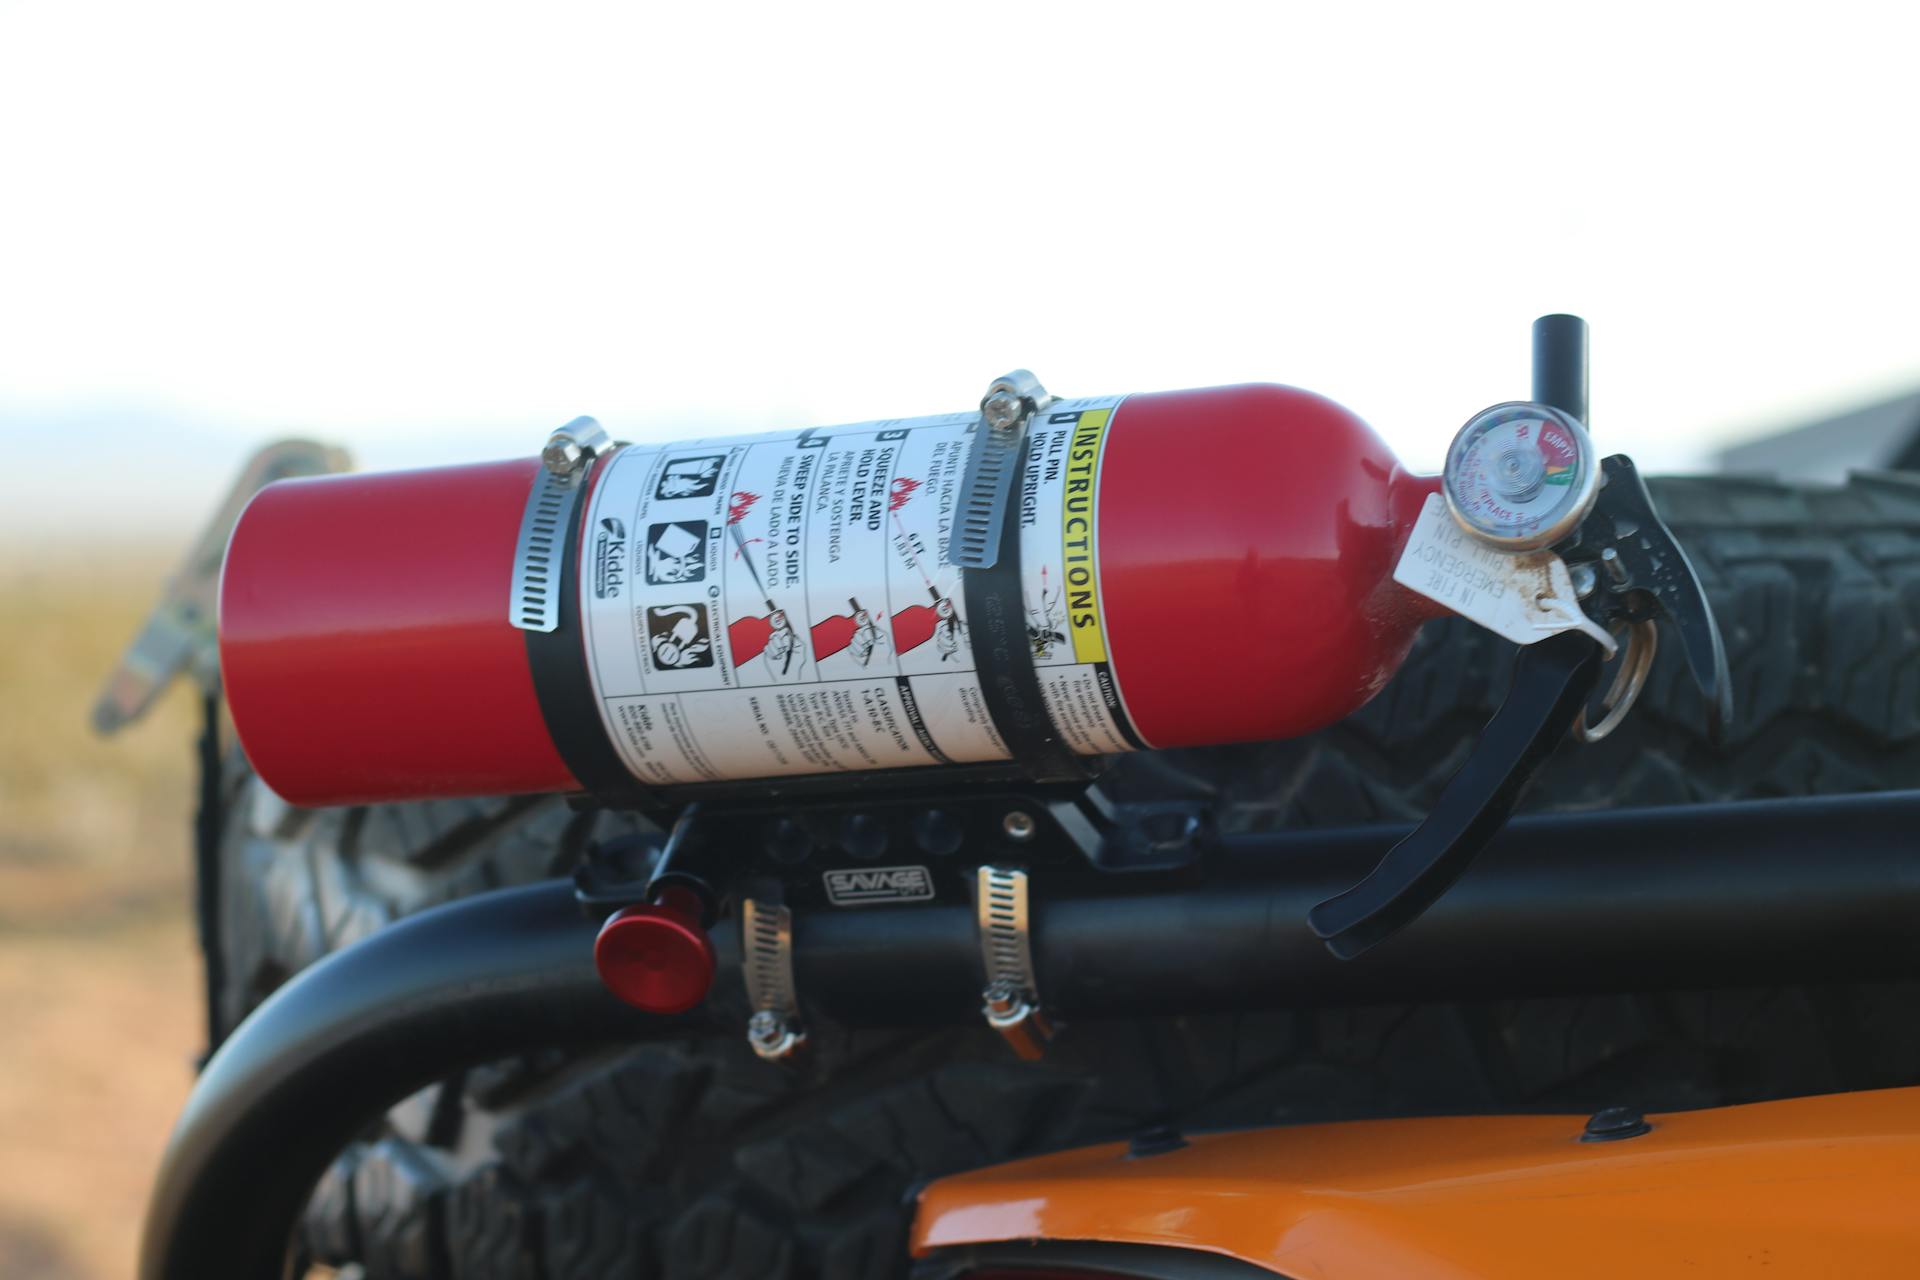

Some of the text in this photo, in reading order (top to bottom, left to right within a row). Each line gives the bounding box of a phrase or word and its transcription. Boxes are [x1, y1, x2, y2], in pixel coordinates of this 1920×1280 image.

[925, 441, 948, 497] DEL FUEGO.
[1043, 430, 1067, 486] PULL PIN.
[1543, 431, 1576, 459] EMPTY
[815, 452, 842, 515] LA PALANCA.
[828, 450, 856, 564] APRIETE Y SOSTENGA
[848, 448, 877, 527] HOLD LEVER.
[867, 448, 894, 531] SQUEEZE AND
[937, 440, 963, 570] APUNTE HACIA LA BASE
[1021, 431, 1048, 530] HOLD UPRIGHT.
[766, 456, 796, 590] MUEVA DE LADO A LADO.
[785, 455, 816, 590] SWEEP SIDE TO SIDE.
[911, 541, 927, 555] FT
[1066, 426, 1100, 629] INSTRUCTIONS
[606, 541, 625, 599] Kidde
[1410, 541, 1507, 600] EMERGENCY
[1426, 569, 1456, 598] FIRE
[710, 600, 722, 642] ELECTRICAL
[637, 705, 653, 731] Kidde
[830, 870, 925, 892] SAVAGE
